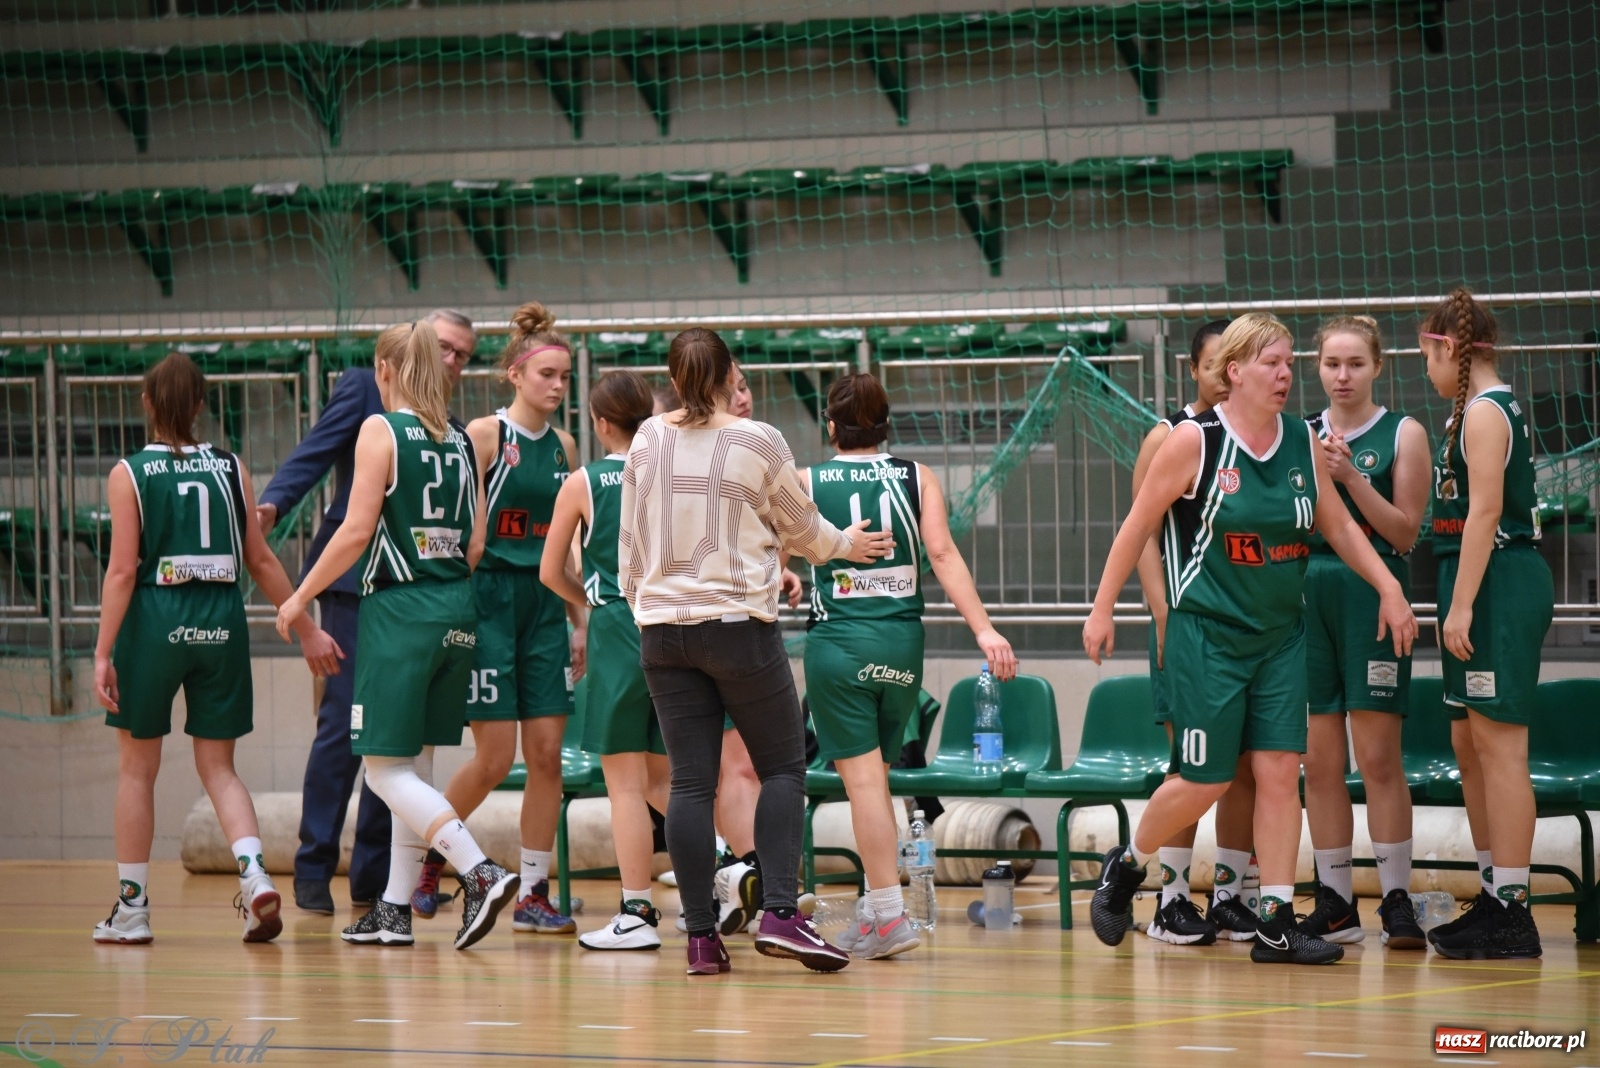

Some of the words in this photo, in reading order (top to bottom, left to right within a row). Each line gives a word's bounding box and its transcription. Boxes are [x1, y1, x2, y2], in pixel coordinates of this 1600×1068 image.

[405, 426, 428, 441] RKK
[143, 459, 169, 477] RKK
[173, 454, 232, 474] RACIBÓRZ
[820, 468, 845, 483] RKK
[850, 463, 909, 482] RACIBÓRZ
[420, 450, 467, 522] 27
[177, 481, 211, 549] 7
[499, 512, 524, 535] K
[1294, 496, 1314, 530] 10
[1228, 536, 1263, 562] K
[183, 626, 230, 641] Clavis
[872, 664, 915, 684] Clavis
[1370, 690, 1394, 698] COLO
[1182, 727, 1207, 767] 10
